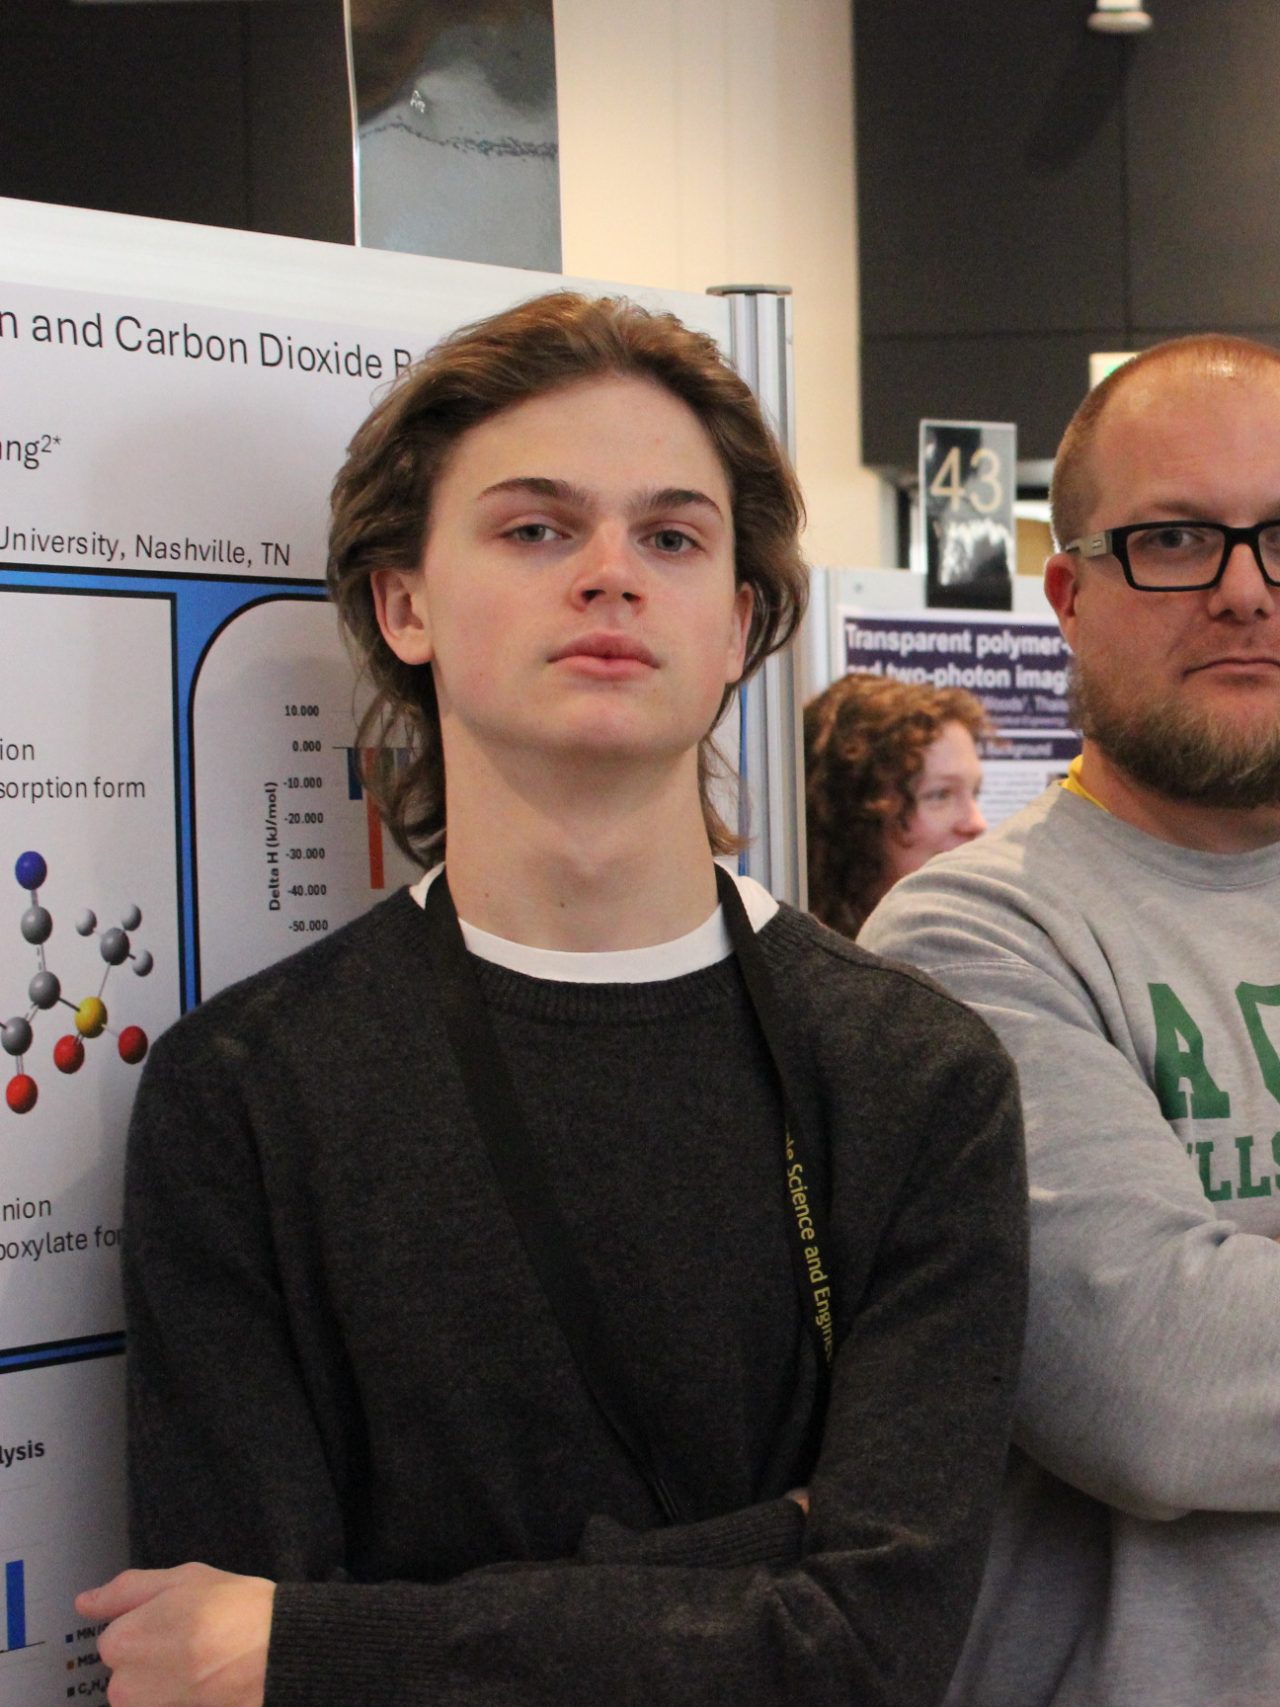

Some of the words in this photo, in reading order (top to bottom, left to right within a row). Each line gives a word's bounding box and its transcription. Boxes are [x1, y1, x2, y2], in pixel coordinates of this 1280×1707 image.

[32, 313, 103, 348] and
[115, 315, 248, 366] Carbon
[259, 332, 383, 379] Dioxide
[930, 446, 1003, 513] 43
[135, 534, 253, 568] Nashville,
[261, 542, 291, 566] TN
[846, 623, 972, 656] Transparent
[1016, 664, 1069, 695] imag
[285, 705, 319, 717] 10.000
[292, 740, 322, 752] 0.000
[94, 776, 146, 798] form
[283, 777, 323, 789] -10.000
[264, 782, 279, 848] (kJ/mol)
[284, 812, 324, 824] -20.000
[267, 852, 279, 864] H
[285, 848, 326, 860] -30.000
[268, 867, 281, 911] Delta
[287, 884, 327, 896] -40.000
[289, 920, 329, 932] -50.000
[787, 1164, 815, 1240] Science
[804, 1246, 829, 1283] and
